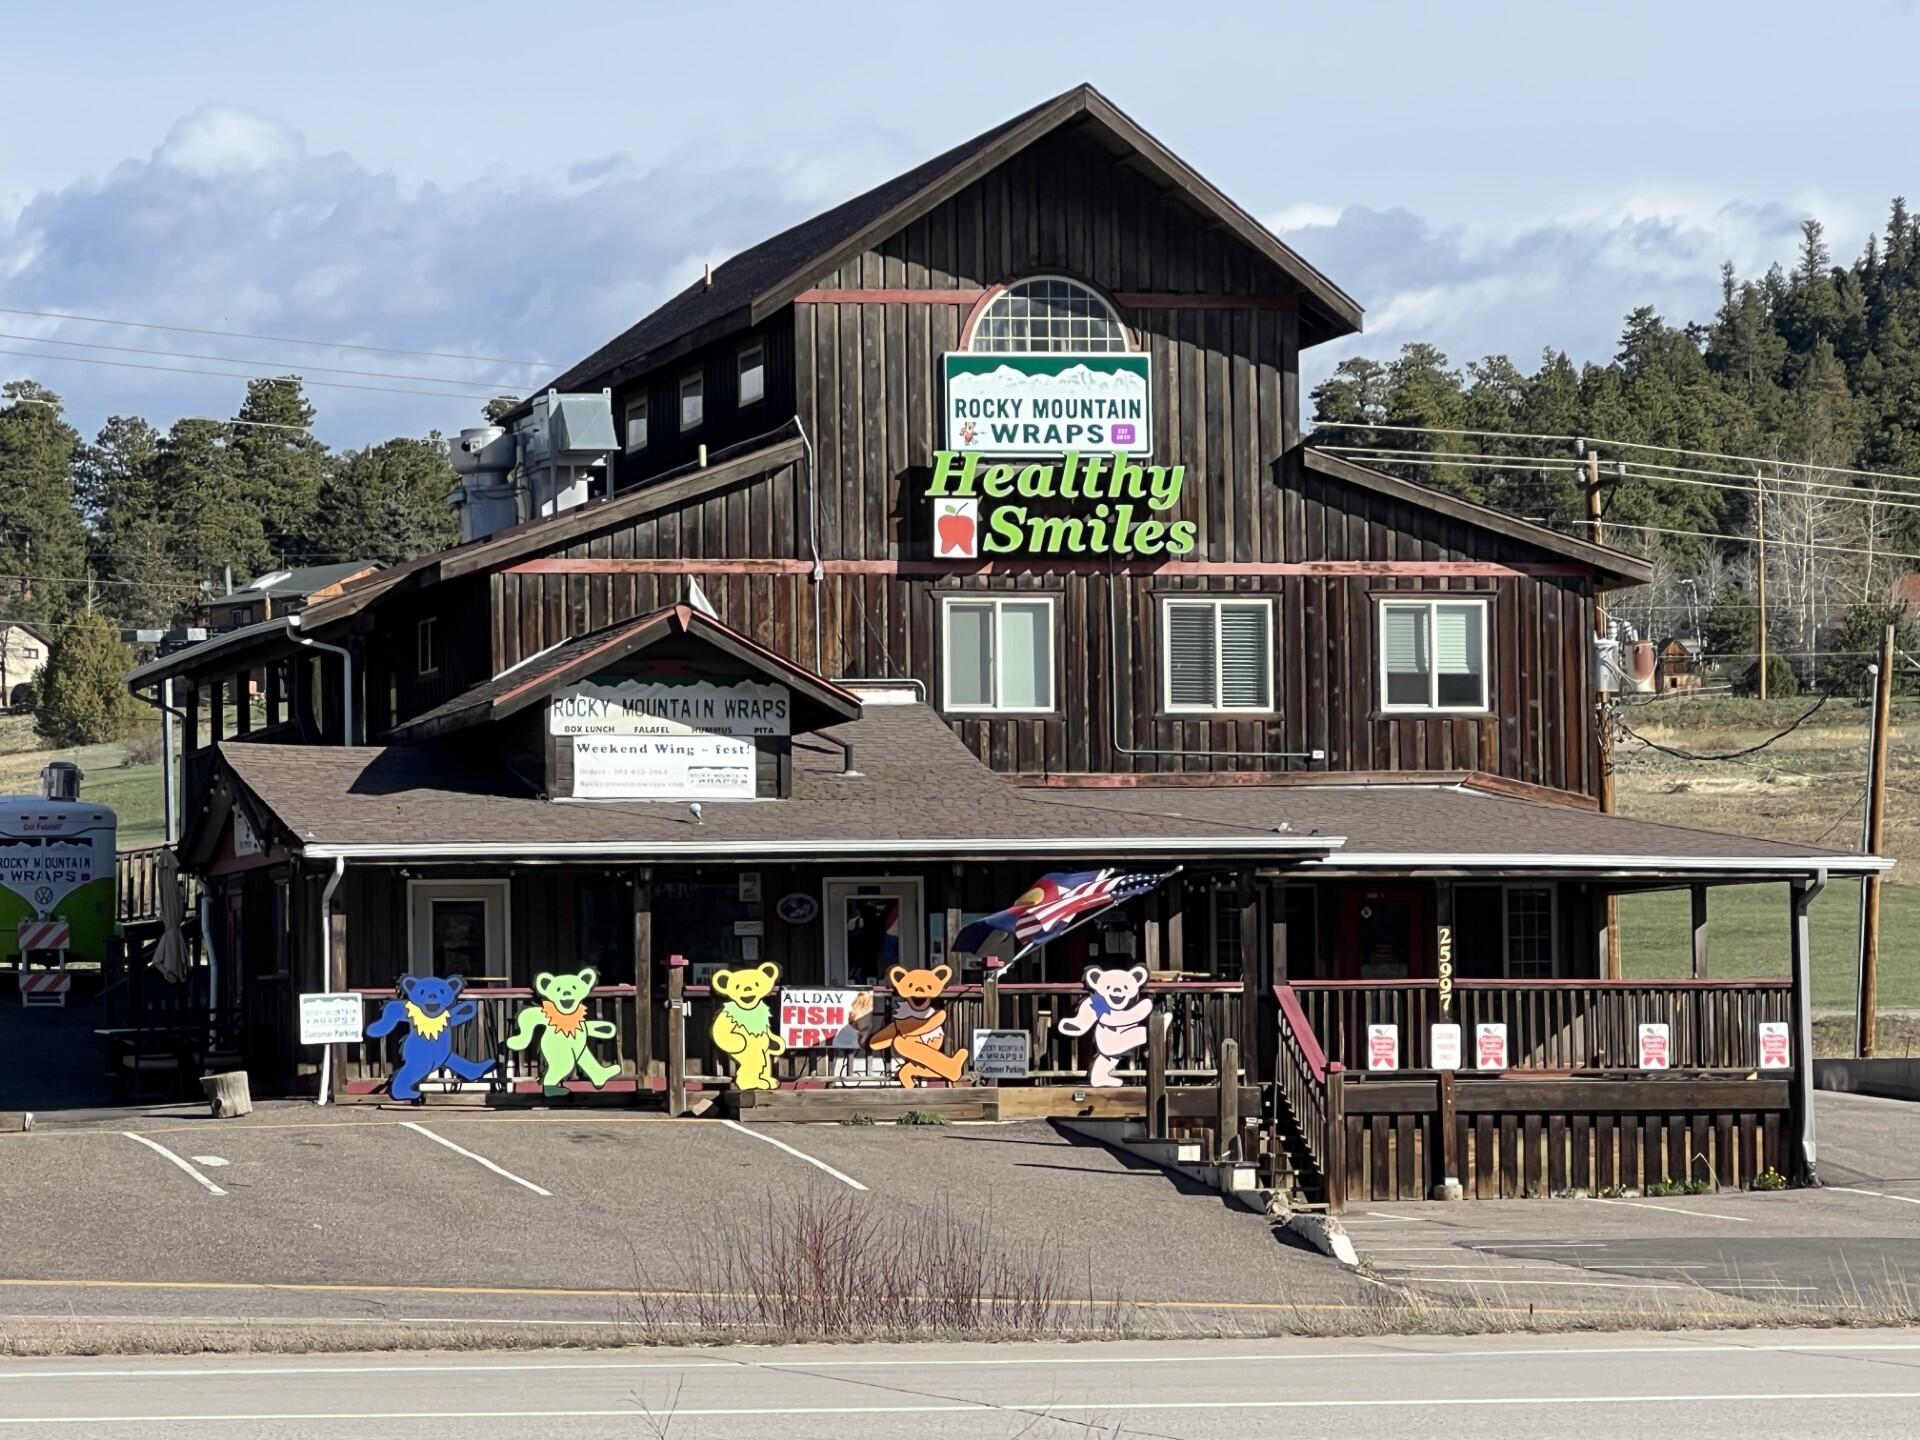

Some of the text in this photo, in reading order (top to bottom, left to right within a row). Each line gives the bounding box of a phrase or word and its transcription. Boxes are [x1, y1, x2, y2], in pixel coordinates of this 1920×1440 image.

[955, 398, 1142, 419] ROCKY MOUNTAIN
[990, 423, 1105, 444] WRAPS
[924, 450, 1186, 510] Healthy
[982, 504, 1197, 555] Smiles
[553, 698, 786, 720] ROCKY MOUNTAIN WRAPS
[564, 725, 583, 733] BOX
[585, 725, 616, 733] LUNCH
[634, 726, 670, 734] FALAFEL
[576, 743, 648, 754] Weekend
[655, 743, 695, 756] Wing
[11, 870, 76, 882] WRAPS
[1439, 928, 1453, 1011] 25997
[782, 1005, 845, 1026] FISH
[788, 1027, 839, 1047] FRY
